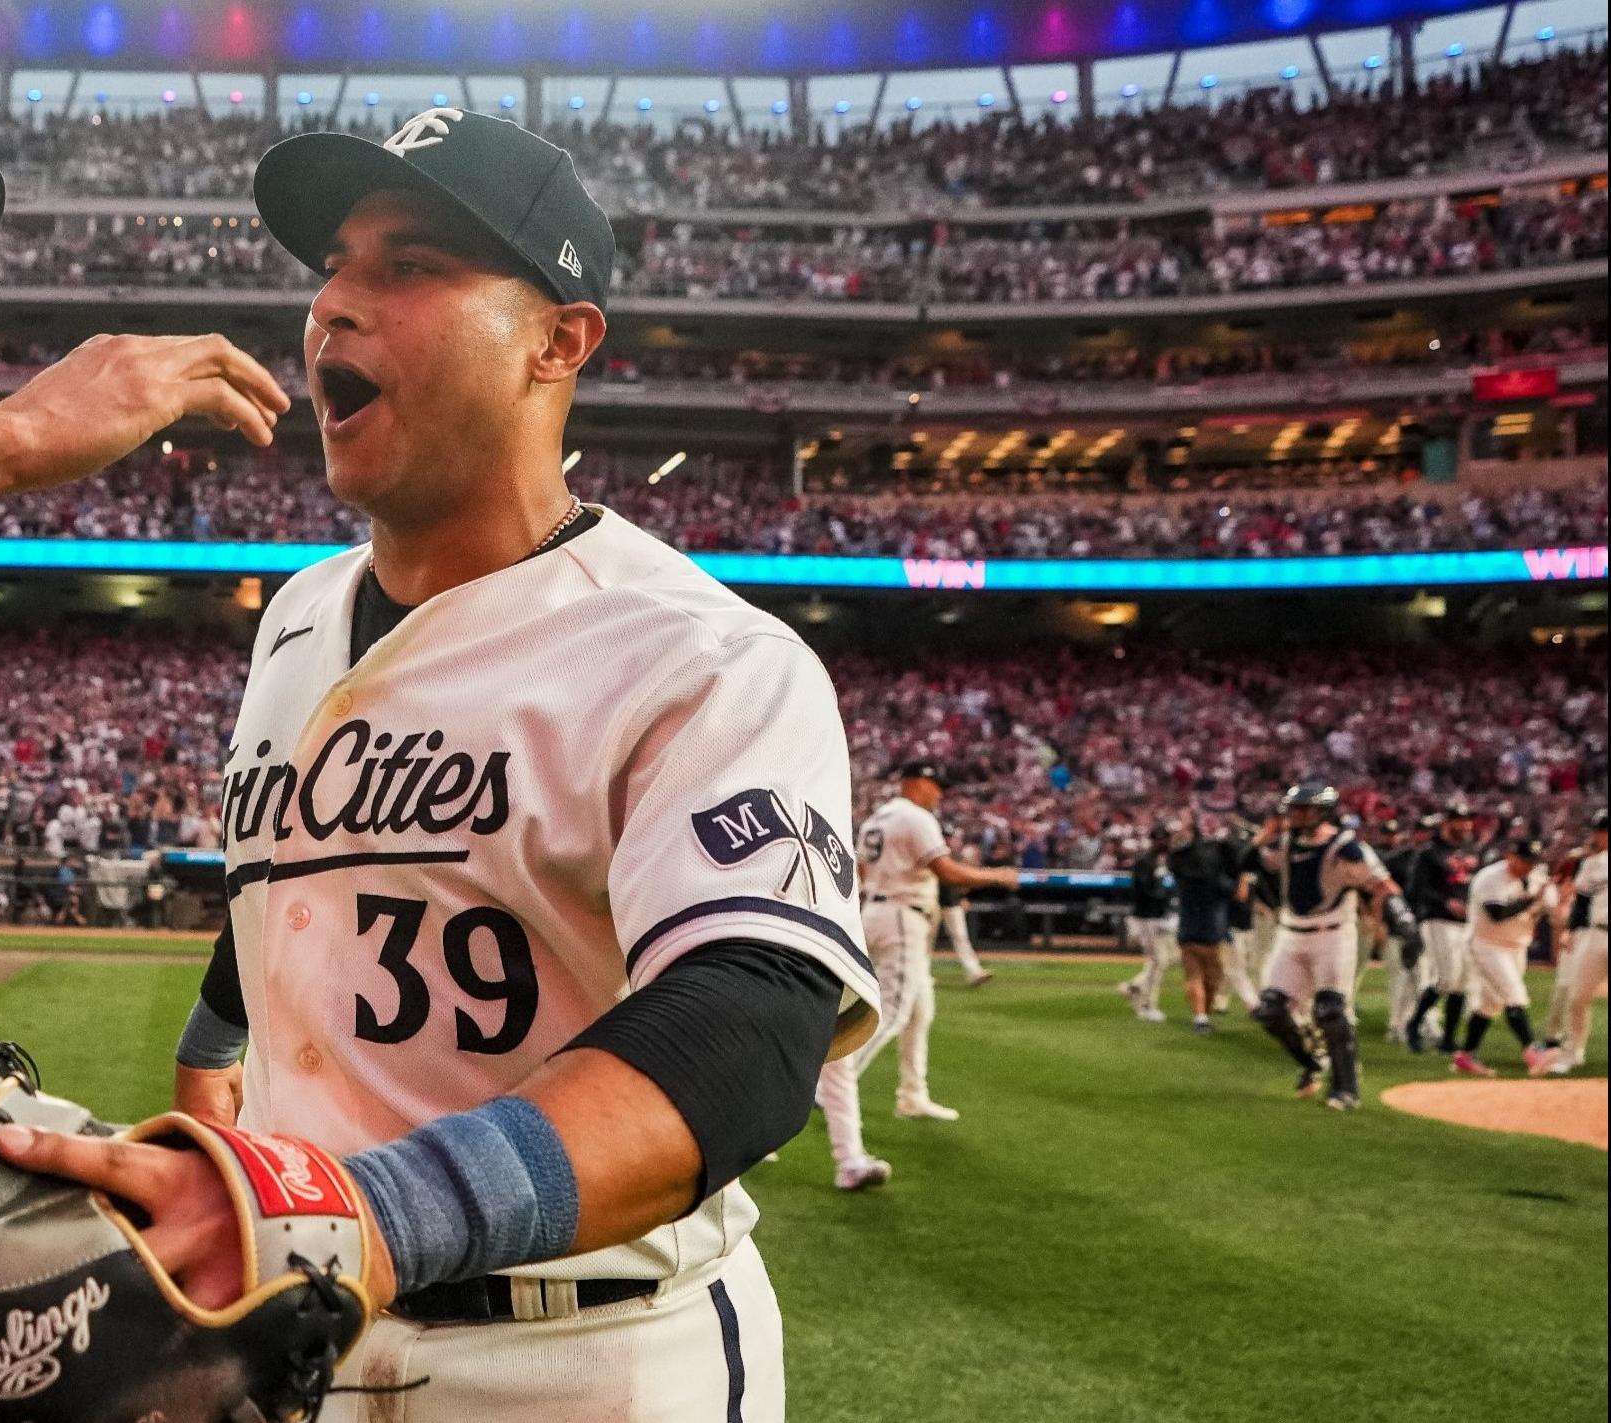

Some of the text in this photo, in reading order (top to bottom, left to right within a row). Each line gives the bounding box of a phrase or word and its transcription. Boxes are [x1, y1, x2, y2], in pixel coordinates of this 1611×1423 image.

[902, 558, 986, 589] WIN
[298, 719, 512, 842] Cities
[711, 802, 771, 850] M
[355, 893, 539, 1055] 39
